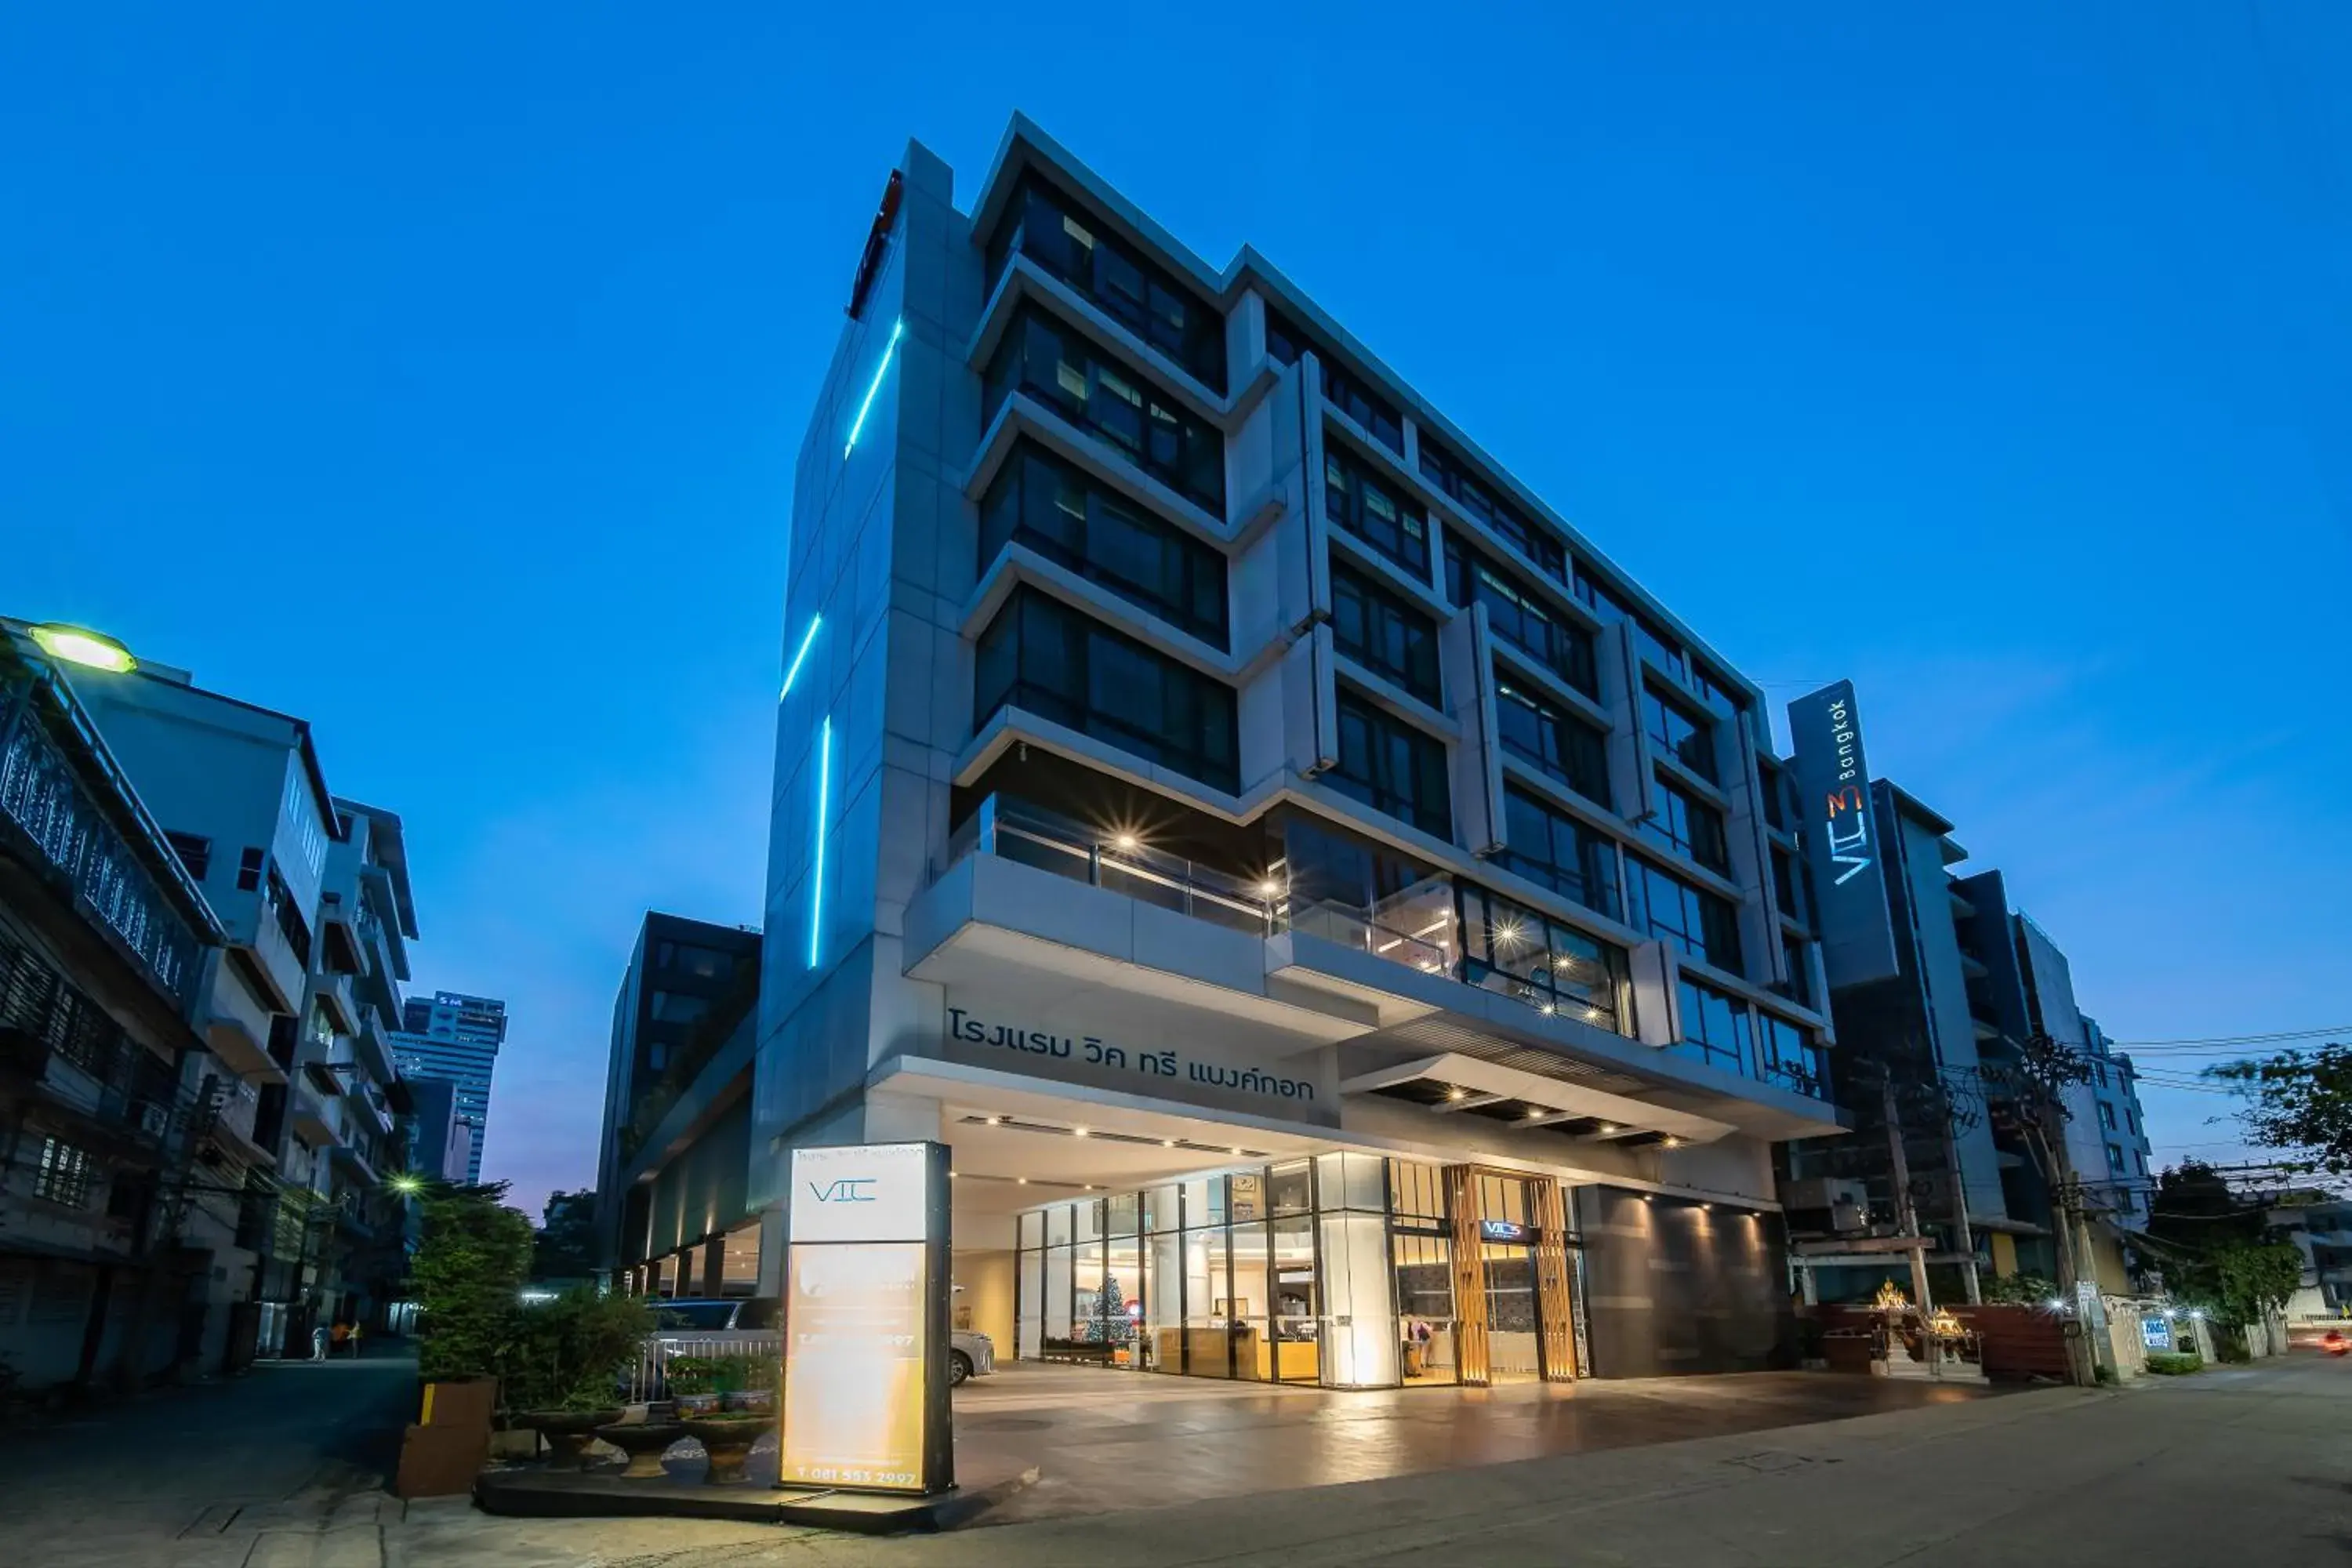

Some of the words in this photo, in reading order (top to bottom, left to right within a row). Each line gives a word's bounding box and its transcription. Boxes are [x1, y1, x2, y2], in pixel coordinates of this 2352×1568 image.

[1828, 699, 1856, 780] Bangkok
[947, 1007, 1071, 1058] โรงแรม
[1083, 1036, 1127, 1069] วิค
[1139, 1051, 1178, 1076] ทรี
[1189, 1061, 1315, 1100] แบงค์กอก
